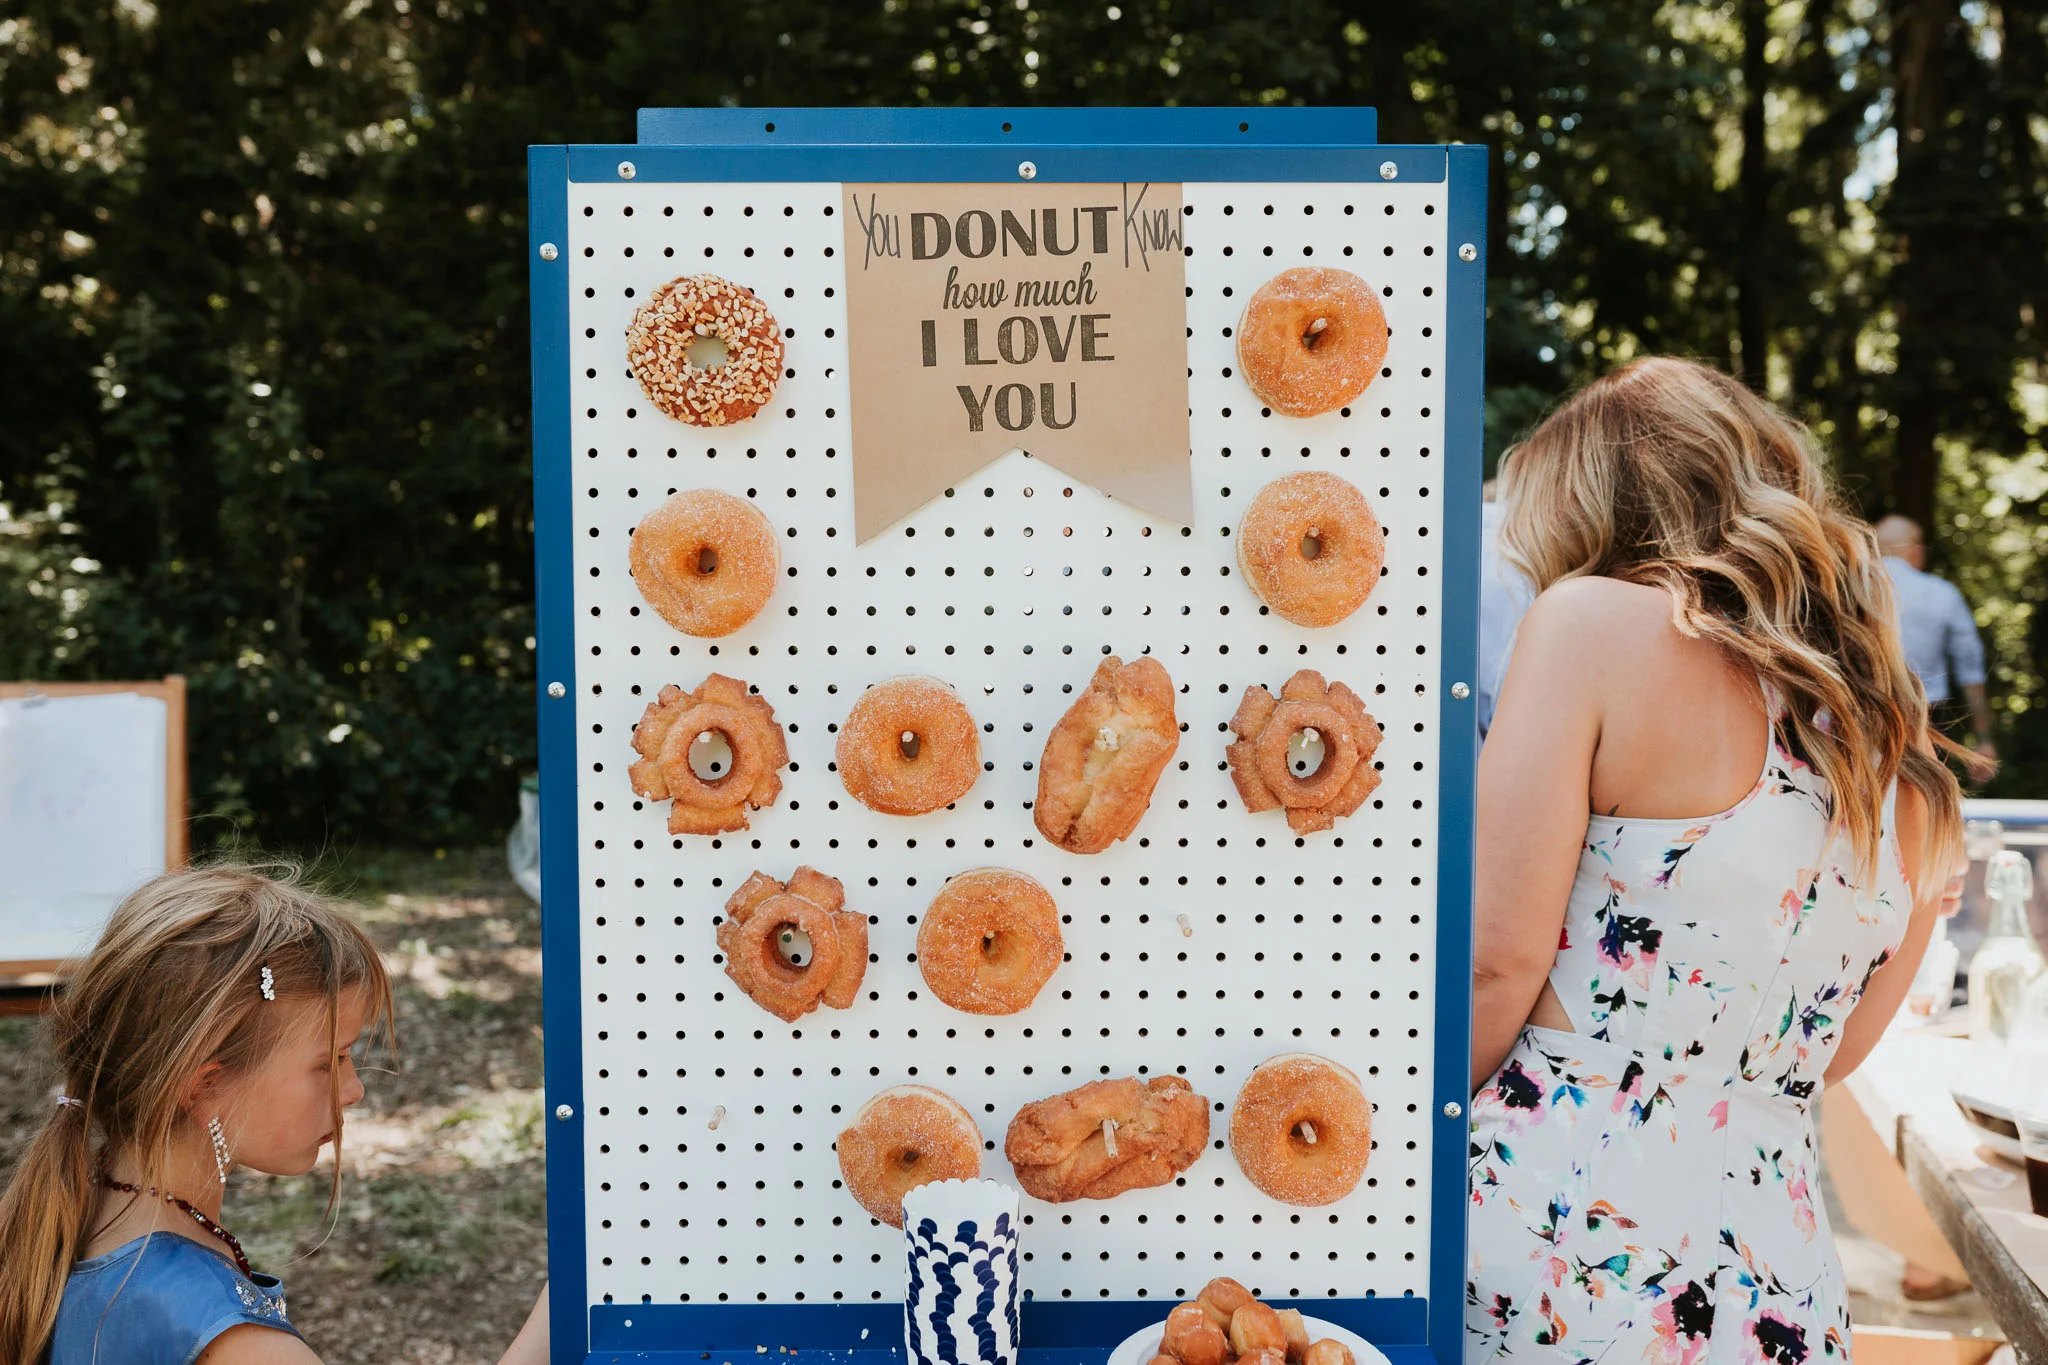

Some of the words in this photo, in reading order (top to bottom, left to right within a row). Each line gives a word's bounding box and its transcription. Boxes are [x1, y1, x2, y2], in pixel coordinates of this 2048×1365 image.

[853, 193, 901, 271] You
[910, 206, 1118, 260] DONUT
[943, 266, 1008, 309] how
[1014, 261, 1097, 307] much
[921, 320, 937, 367] I
[963, 314, 1115, 366] LOVE
[956, 382, 1077, 432] YOU
